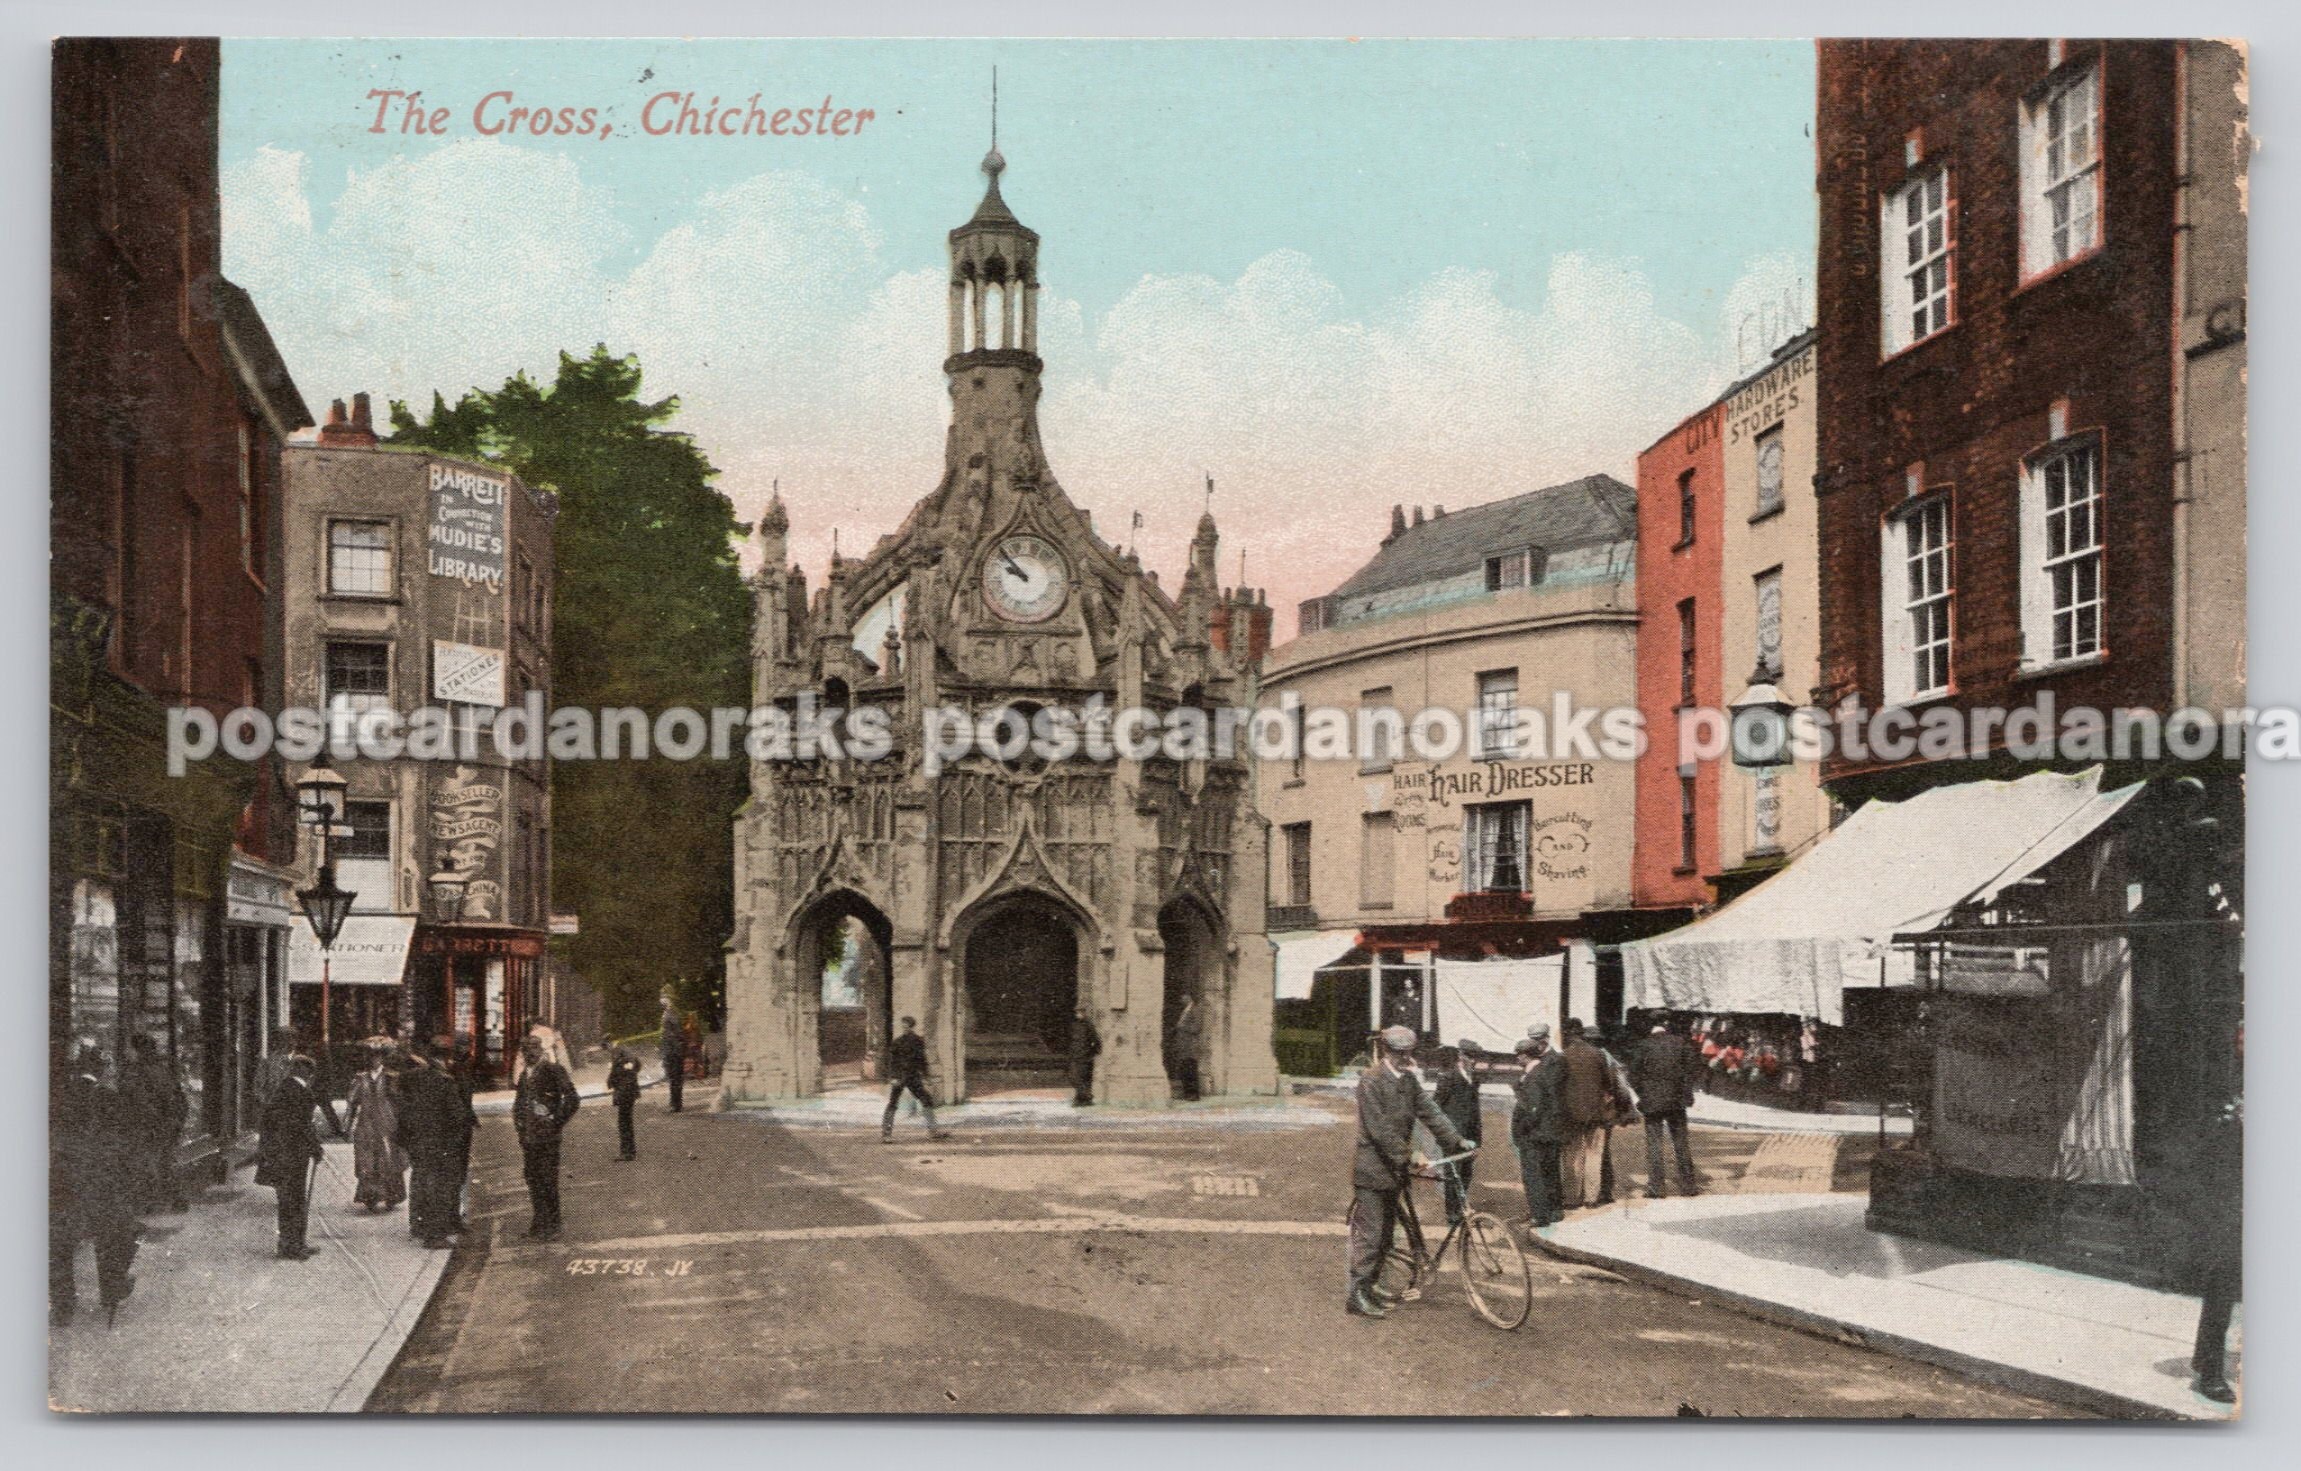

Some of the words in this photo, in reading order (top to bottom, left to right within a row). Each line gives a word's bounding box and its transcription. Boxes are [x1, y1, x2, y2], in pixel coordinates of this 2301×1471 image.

[1726, 349, 1814, 422] HARDWARE
[1731, 386, 1800, 446] STORES
[429, 463, 504, 505] BARRETT
[1393, 773, 1426, 790] HAIR
[1427, 763, 1483, 807] HAIR
[1484, 761, 1594, 798] DRESSER
[431, 820, 500, 837] NEWSAGENT
